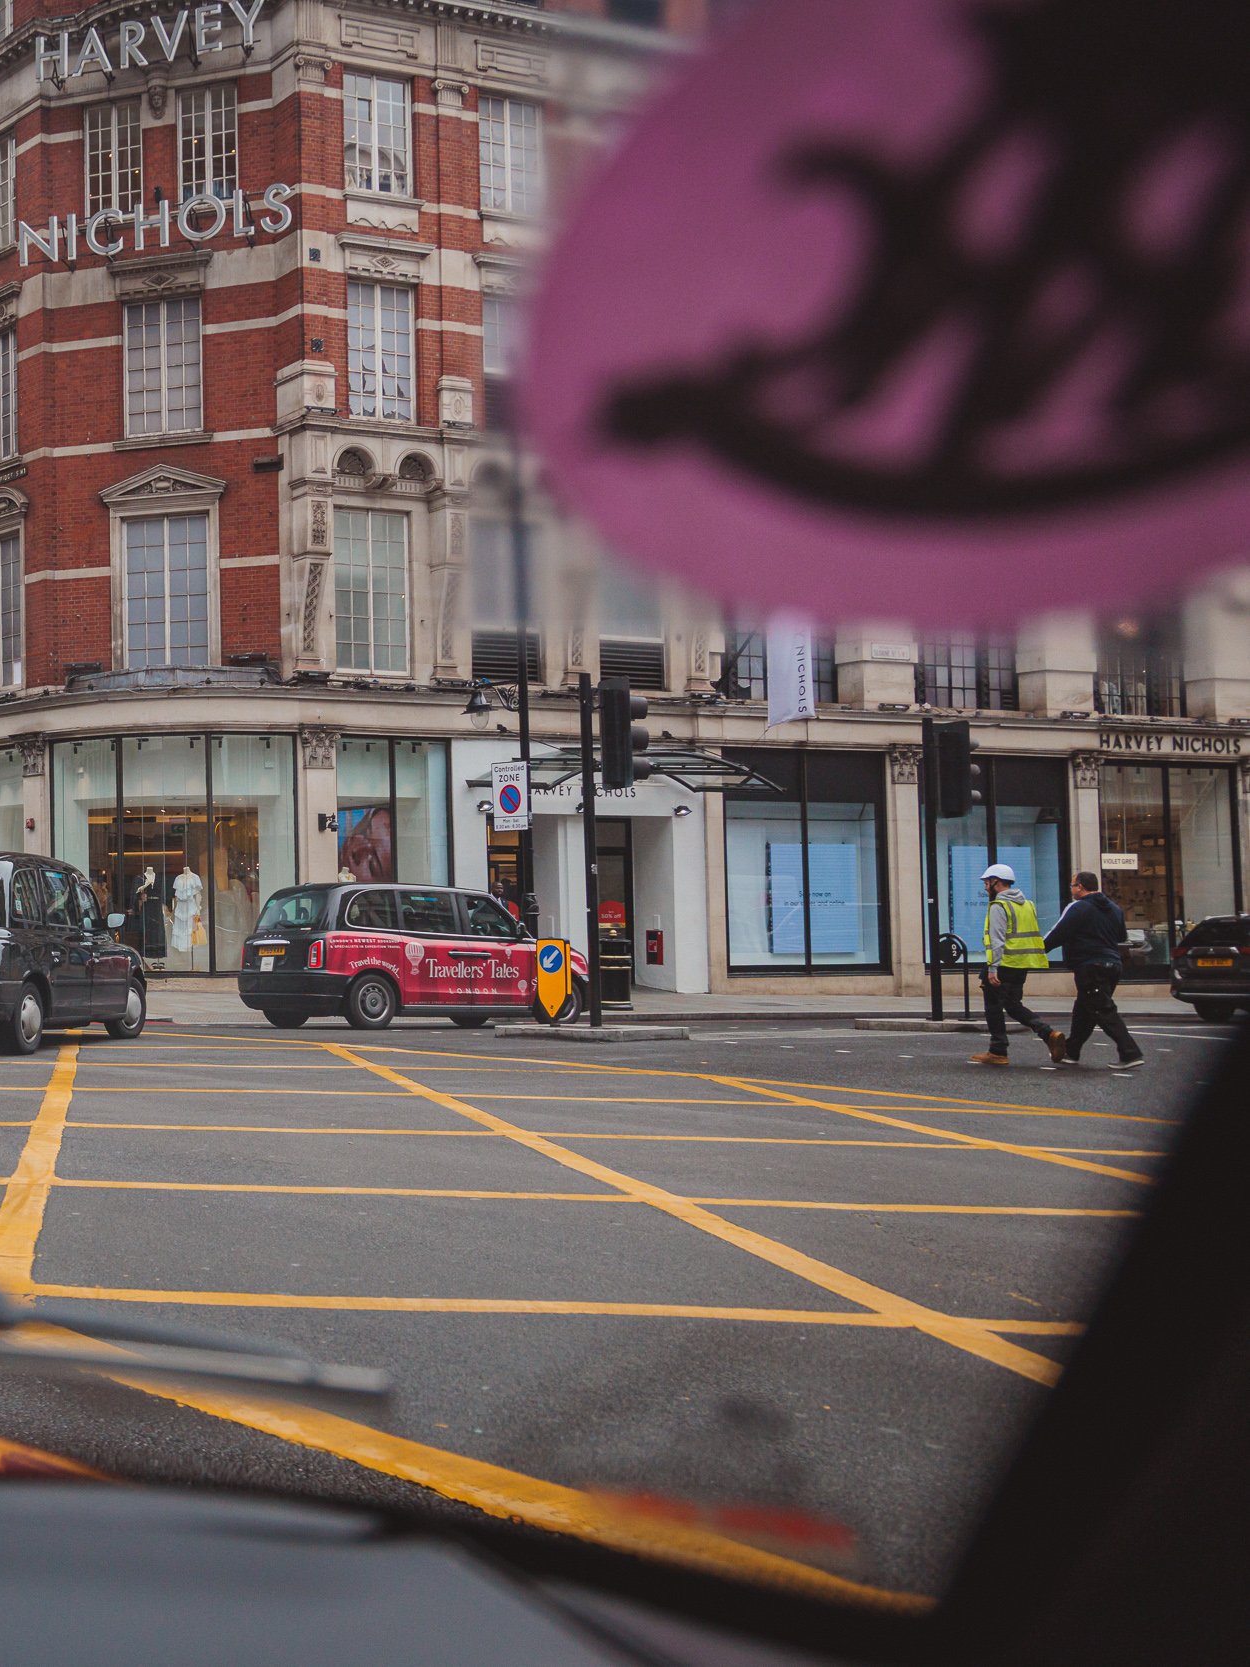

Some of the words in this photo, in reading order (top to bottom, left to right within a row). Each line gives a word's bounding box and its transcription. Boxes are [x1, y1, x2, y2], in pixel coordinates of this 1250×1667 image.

[35, 0, 264, 83] HARVEY
[19, 183, 292, 267] NICHOLS
[796, 645, 808, 713] NICHOLS
[1100, 734, 1164, 752] HARVEY
[1173, 735, 1241, 754] NICHOLS
[494, 764, 525, 773] Controlled
[499, 774, 520, 782] ZONE
[534, 786, 573, 797] ARVEY
[349, 957, 370, 969] Travel
[370, 956, 381, 966] the
[425, 958, 486, 978] Travellers'
[487, 959, 519, 979] Tales
